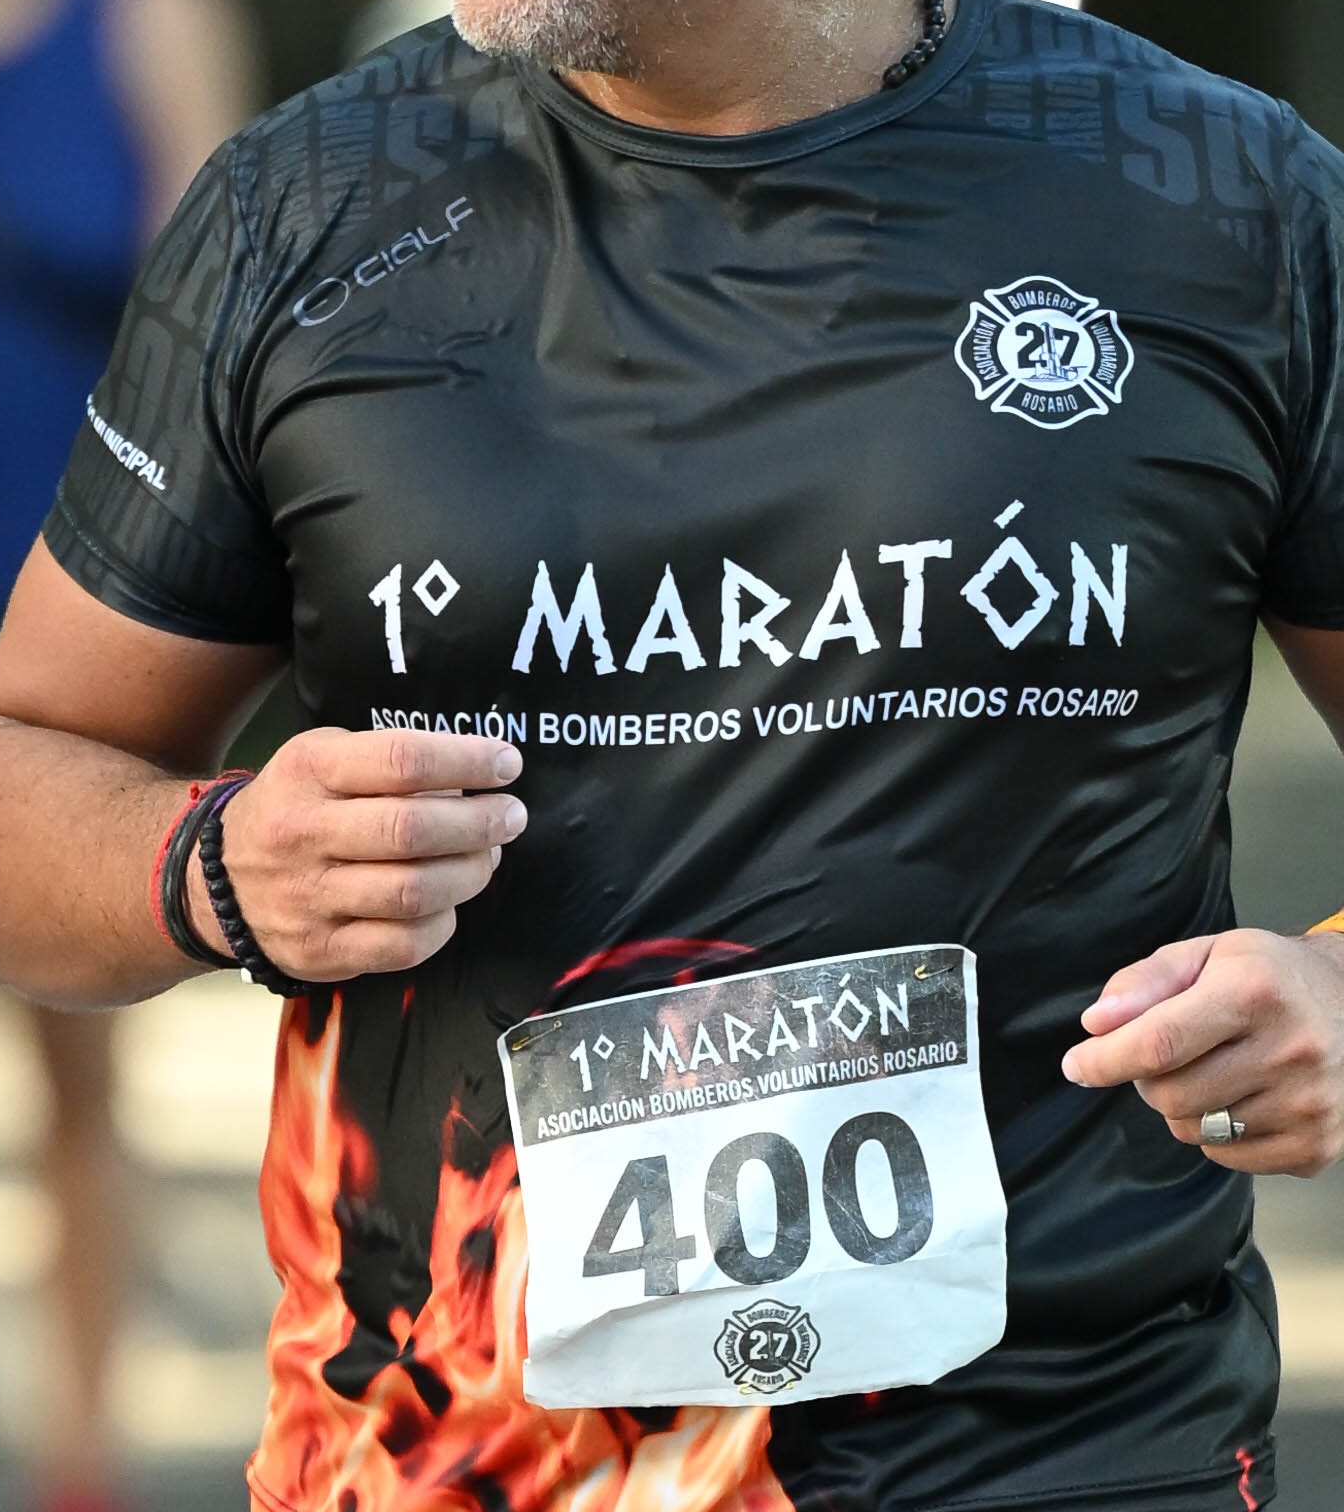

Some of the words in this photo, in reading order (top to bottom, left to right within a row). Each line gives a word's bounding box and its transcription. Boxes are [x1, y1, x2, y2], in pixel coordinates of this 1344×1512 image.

[1007, 289, 1078, 311] BOMBEROS
[972, 318, 1001, 381] ASOCIACIÓN
[1014, 320, 1081, 370] 27
[1020, 392, 1079, 413] ROSARIO
[511, 499, 1129, 676] MARATÓN
[539, 708, 742, 746] BOMBEROS
[752, 686, 1009, 737] VOLUNTARIOS
[1016, 687, 1139, 717] ROSARIO
[639, 973, 910, 1082] MARATÓN
[536, 1095, 646, 1140] ASOCIACIÓN
[649, 1078, 755, 1117] BOMBEROS
[756, 1054, 880, 1096] VOLUNTARIOS
[883, 1040, 958, 1074] ROSARIO
[582, 1111, 934, 1297] 400
[749, 1329, 789, 1361] 27
